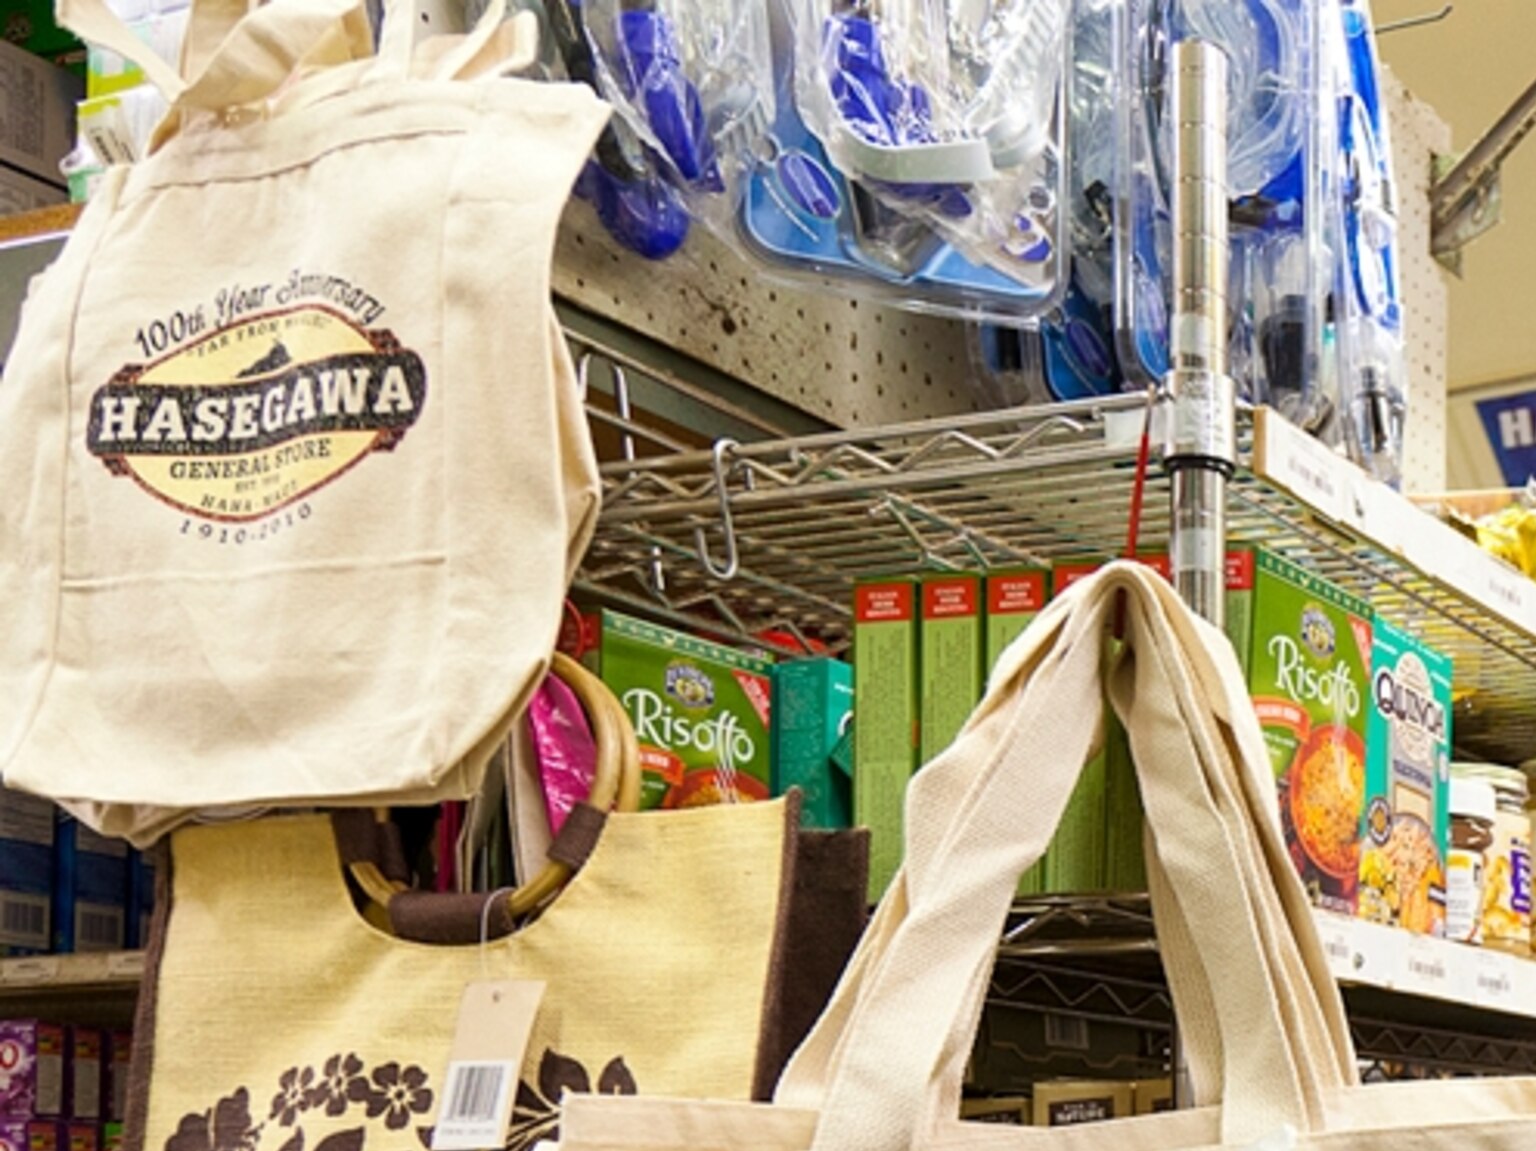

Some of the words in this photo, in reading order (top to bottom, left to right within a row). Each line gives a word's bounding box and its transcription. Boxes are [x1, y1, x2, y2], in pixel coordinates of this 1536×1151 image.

[133, 303, 206, 358] 100th
[98, 364, 414, 442] HASEGAWA
[169, 454, 271, 480] GENERAL
[274, 437, 332, 470] STORE
[1268, 633, 1360, 719] Risotto
[622, 687, 755, 762] Risotto
